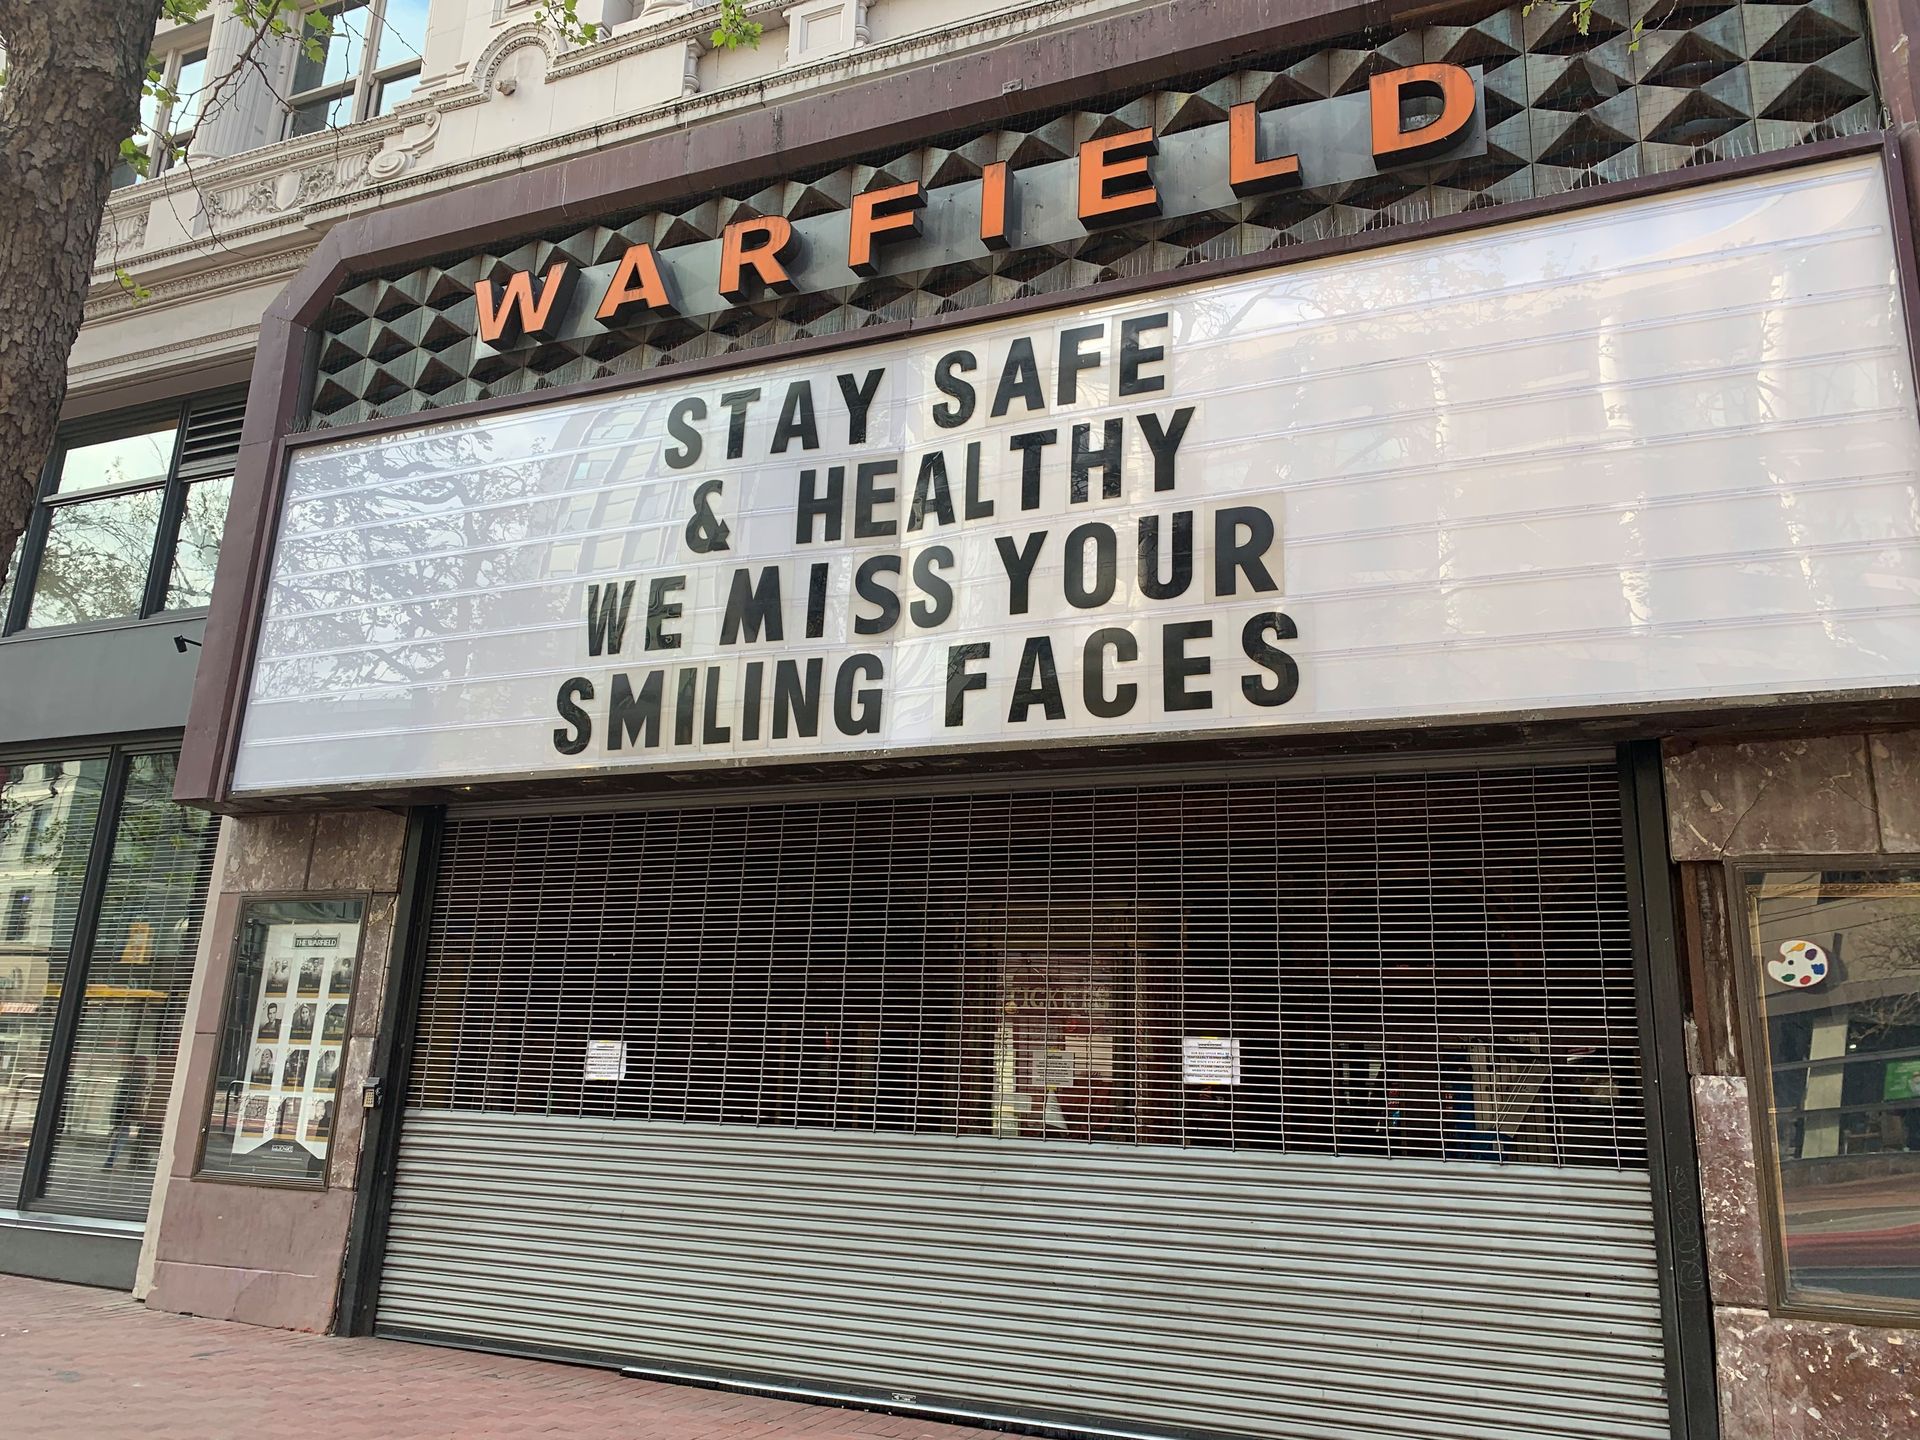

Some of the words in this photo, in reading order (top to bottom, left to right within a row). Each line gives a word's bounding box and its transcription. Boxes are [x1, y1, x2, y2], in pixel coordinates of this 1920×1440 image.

[475, 61, 1480, 347] WARFIELD
[664, 367, 886, 469] STAY
[932, 312, 1170, 429] SAFE
[685, 479, 731, 554] &
[795, 406, 1196, 545] HEALTHY
[587, 575, 687, 657] WE
[719, 545, 955, 646] MISS
[994, 506, 1279, 615] YOUR
[553, 653, 885, 756] SMILING
[944, 611, 1300, 728] FACES
